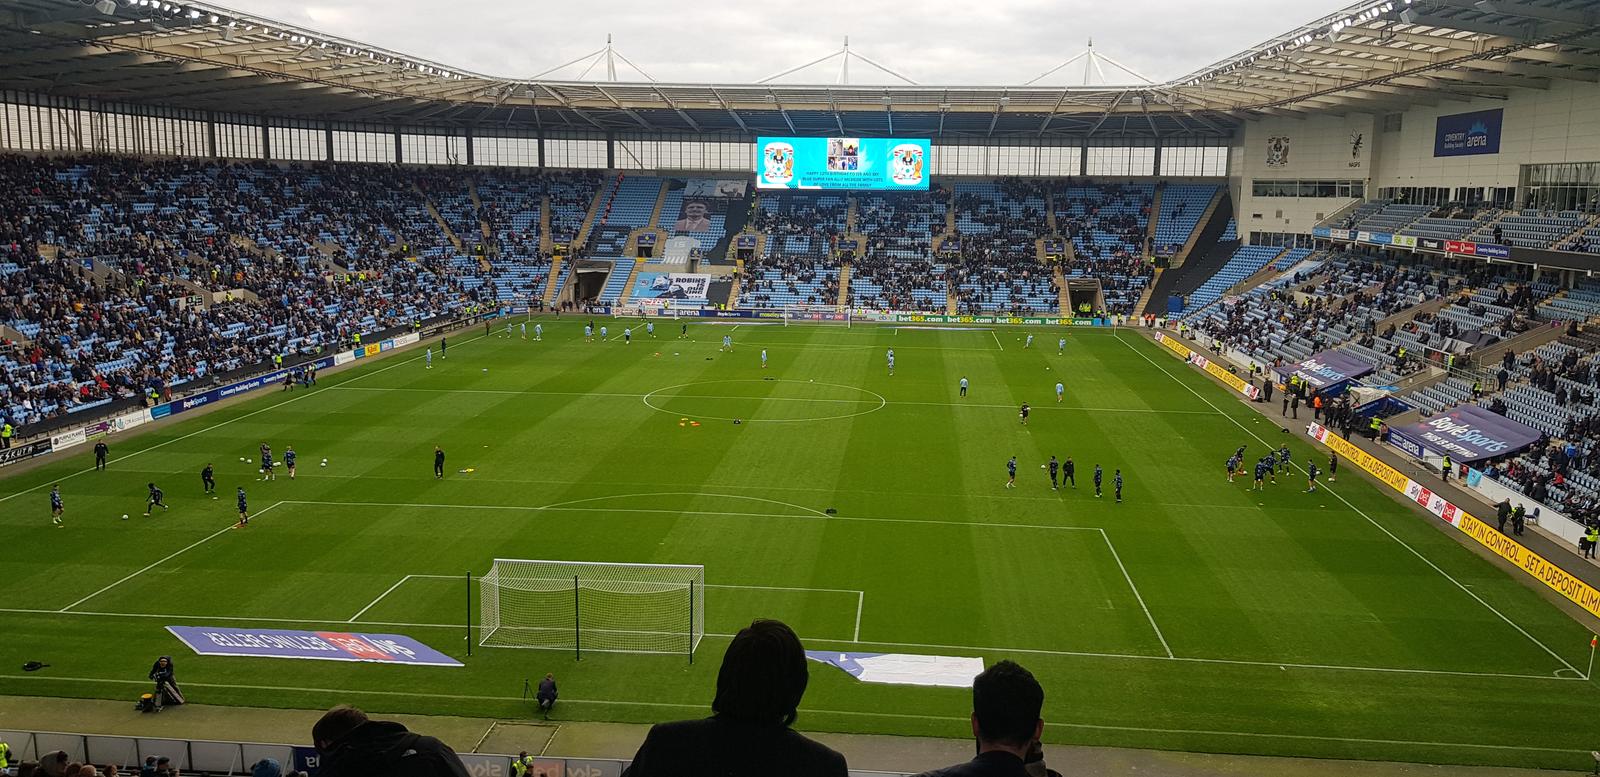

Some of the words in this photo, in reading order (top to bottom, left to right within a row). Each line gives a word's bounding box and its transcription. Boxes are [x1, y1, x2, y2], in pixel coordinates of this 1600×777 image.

[1444, 132, 1465, 142] COVENTRY
[1466, 136, 1486, 147] arena
[220, 387, 236, 396] Coventry
[235, 383, 249, 391] Building
[184, 396, 207, 408] BoyleSports
[1420, 431, 1437, 443] THIS
[1429, 416, 1508, 452] BoyleSports
[1402, 438, 1419, 456] arena
[1372, 461, 1393, 481] DEPOSIT
[1411, 485, 1420, 498] sky
[1420, 490, 1429, 502] bet
[1434, 500, 1444, 514] sky
[1444, 505, 1455, 520] bet
[1462, 516, 1478, 533] STAY
[1476, 526, 1486, 539] IN
[1486, 530, 1520, 562] CONTROL.
[1525, 554, 1540, 573] SET
[1538, 564, 1544, 578] A
[1546, 567, 1582, 600] DEPOSIT
[202, 632, 272, 649] BETTER
[268, 634, 338, 651] BETTING
[361, 635, 416, 660] sky
